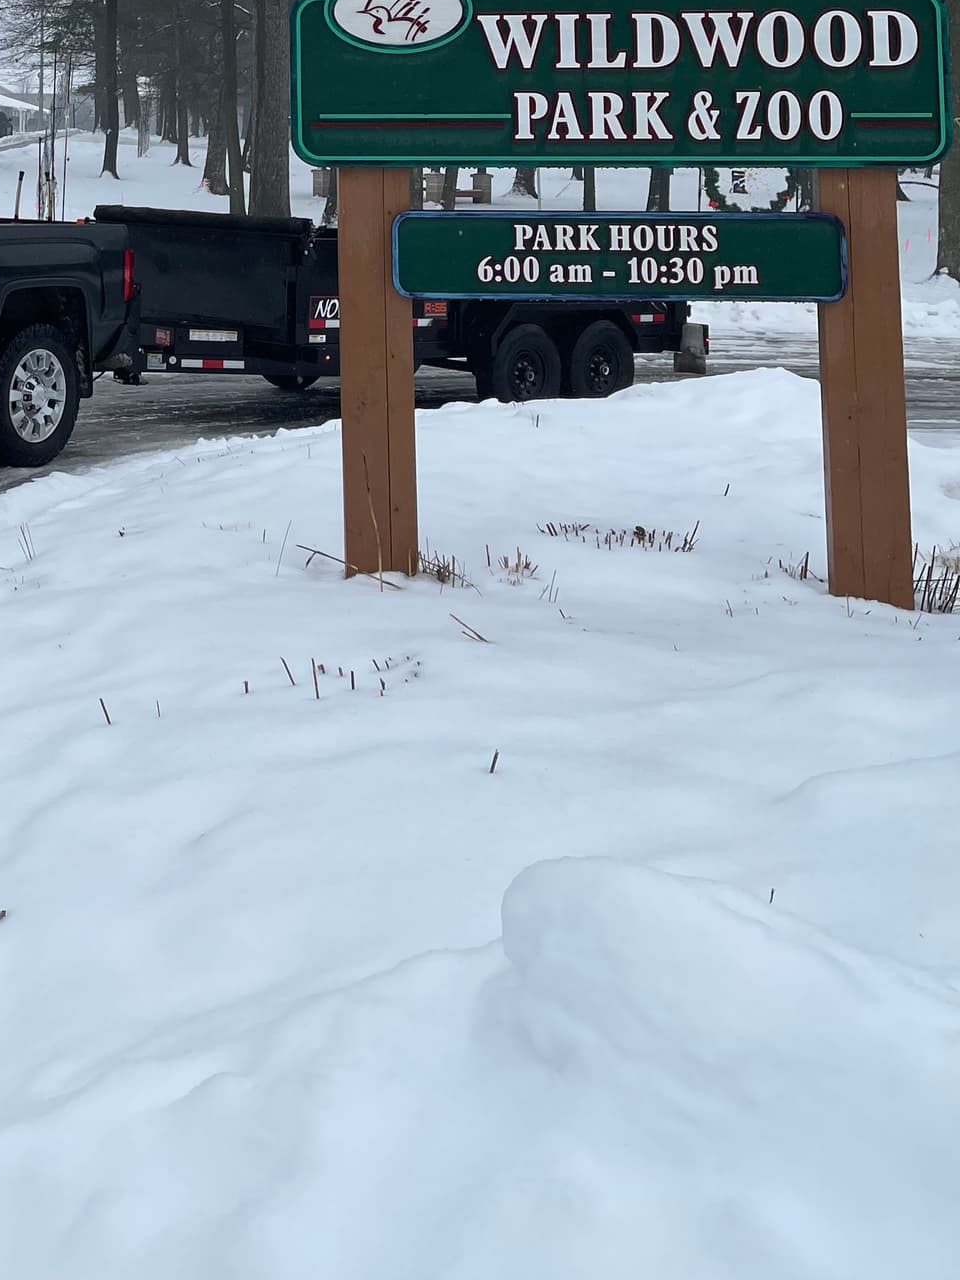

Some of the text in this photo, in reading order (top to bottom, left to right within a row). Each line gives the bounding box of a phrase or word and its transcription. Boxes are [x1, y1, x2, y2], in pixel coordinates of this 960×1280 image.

[477, 10, 919, 69] WILDWOOD
[513, 90, 843, 141] PARK & ZOO
[513, 224, 719, 252] PARK HOURS
[477, 256, 540, 283] 6:00
[549, 264, 593, 283] am
[627, 256, 704, 284] 10:30
[713, 264, 759, 290] pm
[314, 298, 340, 319] NO
